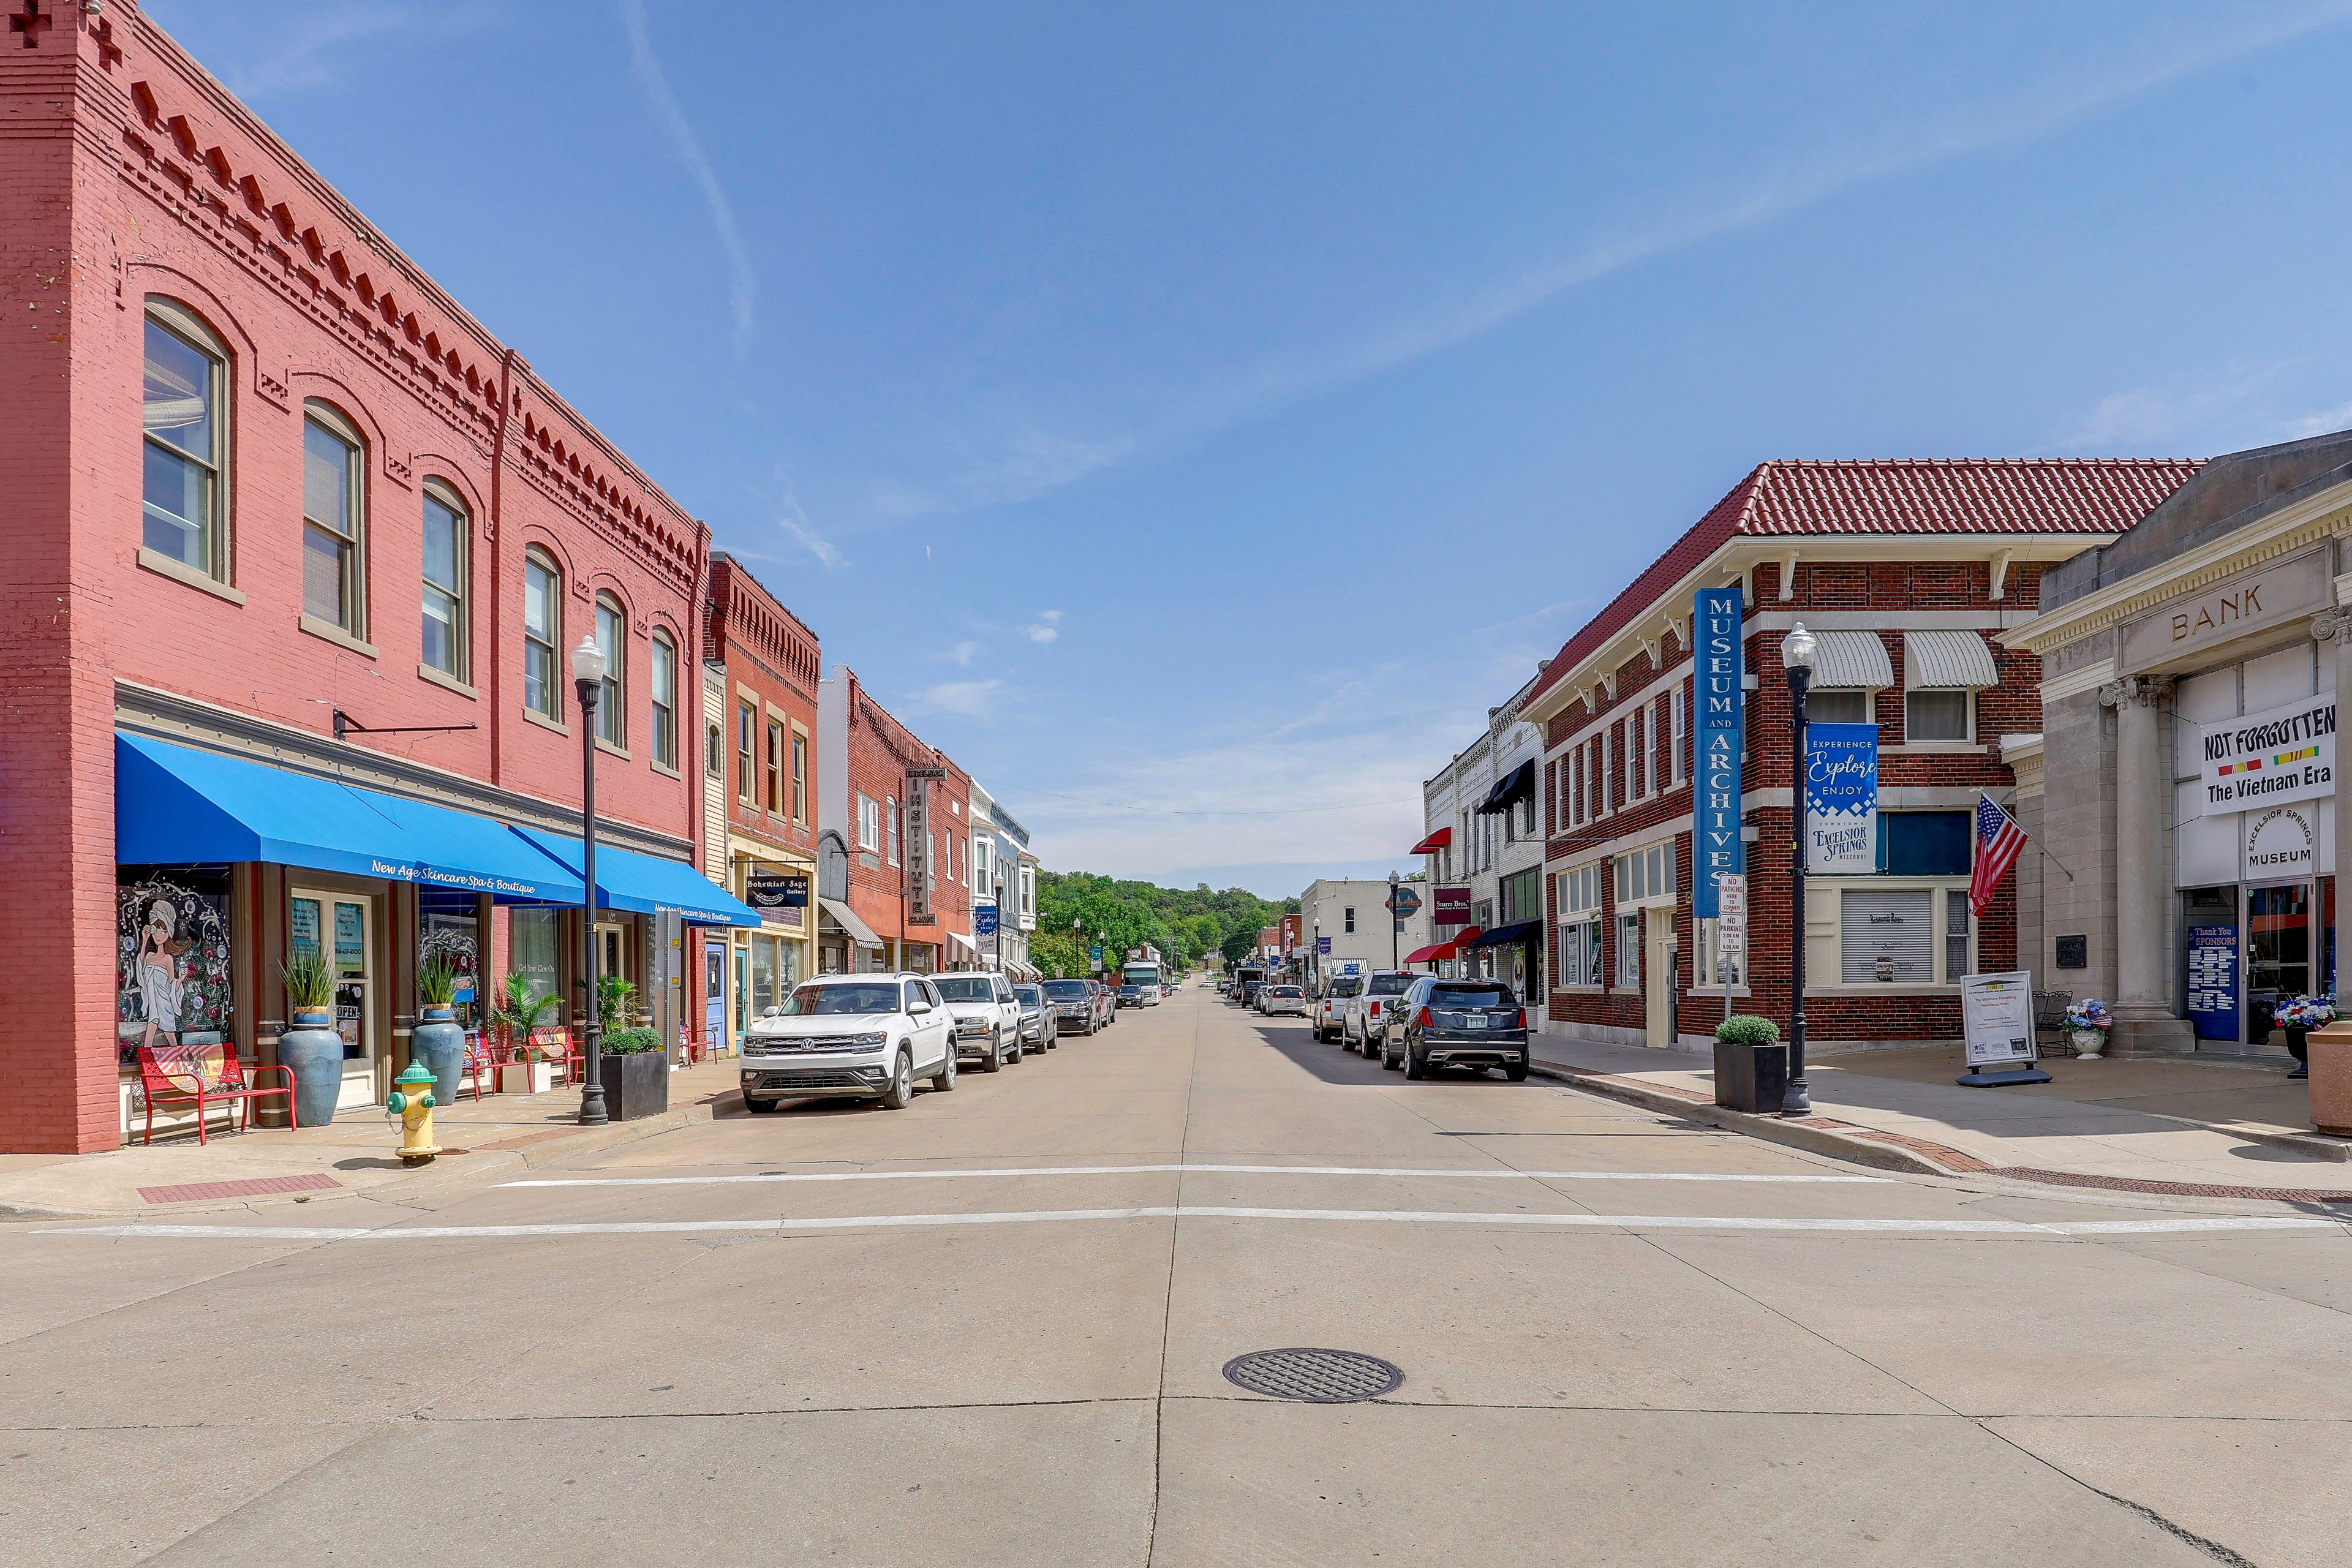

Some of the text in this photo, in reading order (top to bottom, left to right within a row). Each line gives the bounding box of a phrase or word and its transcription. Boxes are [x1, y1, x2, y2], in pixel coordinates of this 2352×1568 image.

[2171, 584, 2263, 642] BANK
[1708, 599, 1733, 713] MUSEUM
[2204, 704, 2336, 761] NOT FORGOTTEN
[1807, 751, 1877, 785] Explore
[1822, 786, 1863, 795] ENJOY
[2207, 766, 2331, 803] The Vietnam Era
[1812, 827, 1867, 846] EXCELSIOR
[2248, 809, 2313, 852] EXCELSIOR SPRINGS
[910, 778, 923, 914] INSTITUTE
[1823, 839, 1868, 862] SPRINGS
[2249, 850, 2312, 867] MUSEUM
[371, 859, 536, 895] New Age Skincare Spa & Boutique
[789, 880, 807, 889] Sage
[607, 912, 616, 922] 102
[655, 903, 666, 912] New
[698, 910, 707, 920] Spa
[712, 913, 732, 923] Boutique
[976, 915, 997, 926] Explore
[2195, 927, 2217, 936] Thank
[2195, 937, 2237, 946] SPONSORS
[337, 1006, 357, 1017] OPEN
